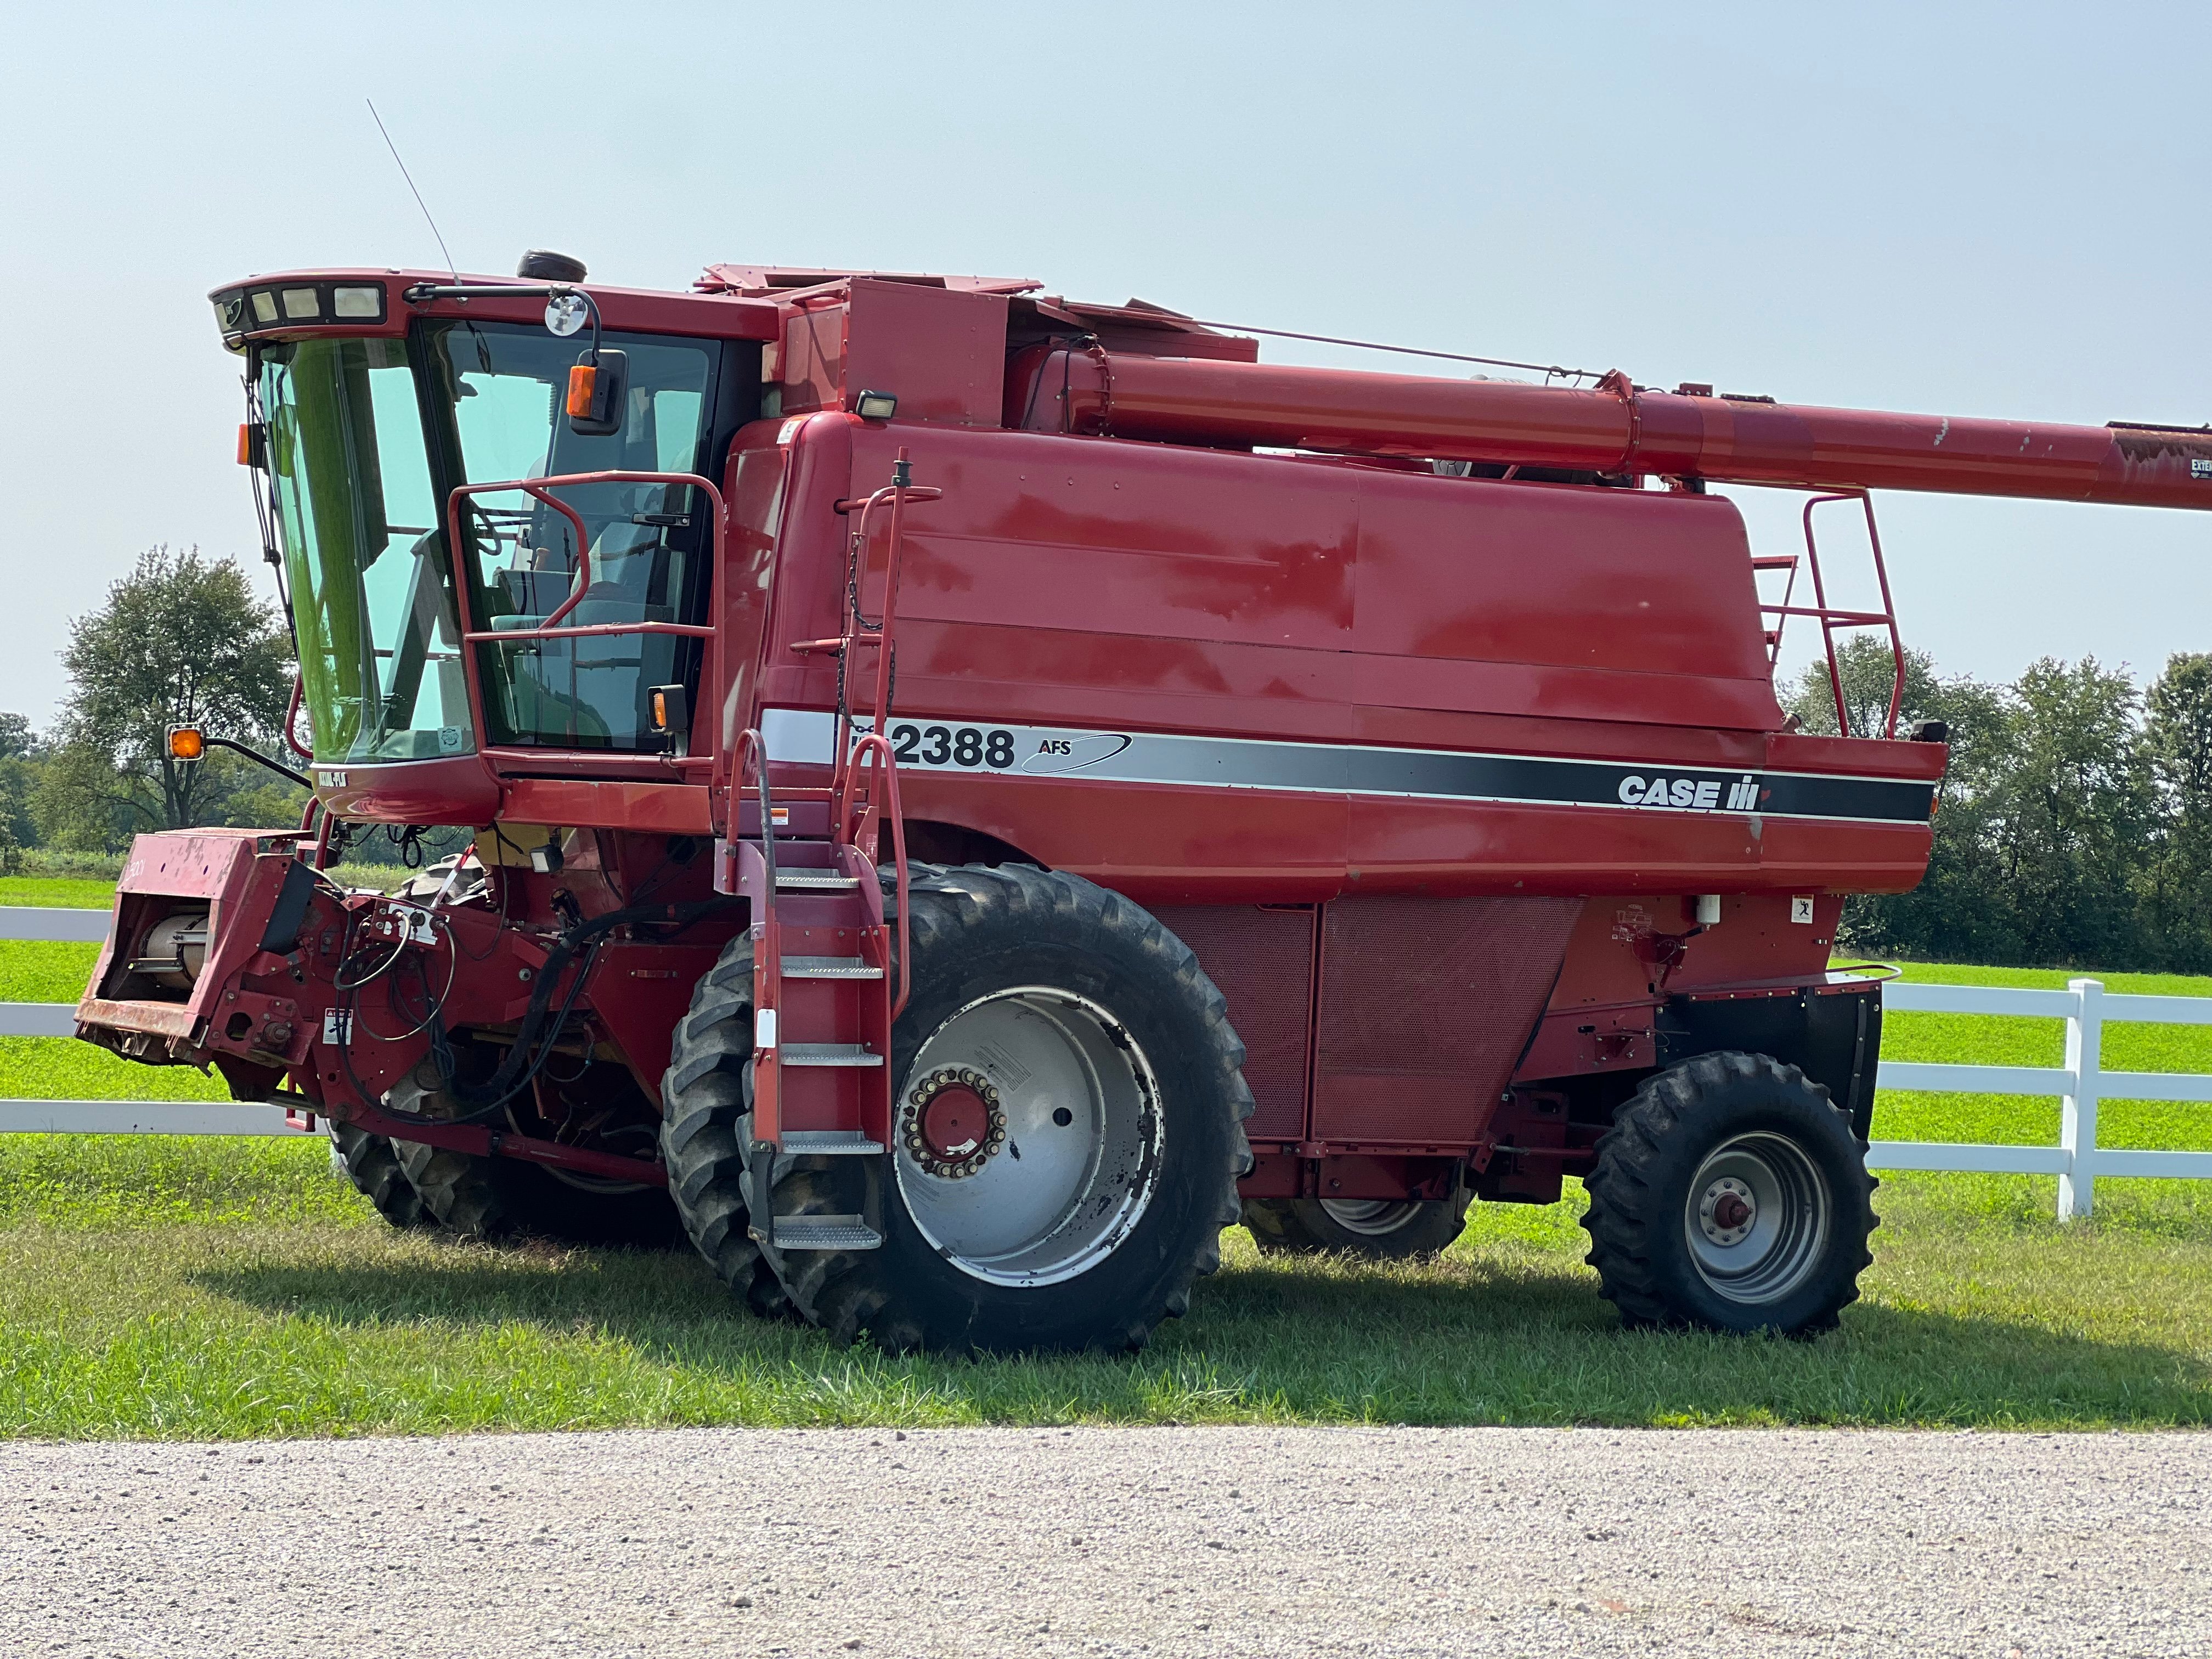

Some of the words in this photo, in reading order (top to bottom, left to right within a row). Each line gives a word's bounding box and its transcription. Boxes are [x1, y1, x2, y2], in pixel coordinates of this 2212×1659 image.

[891, 724, 1014, 768] 2388
[1039, 740, 1071, 755] AFS
[1618, 775, 1722, 808] CASE
